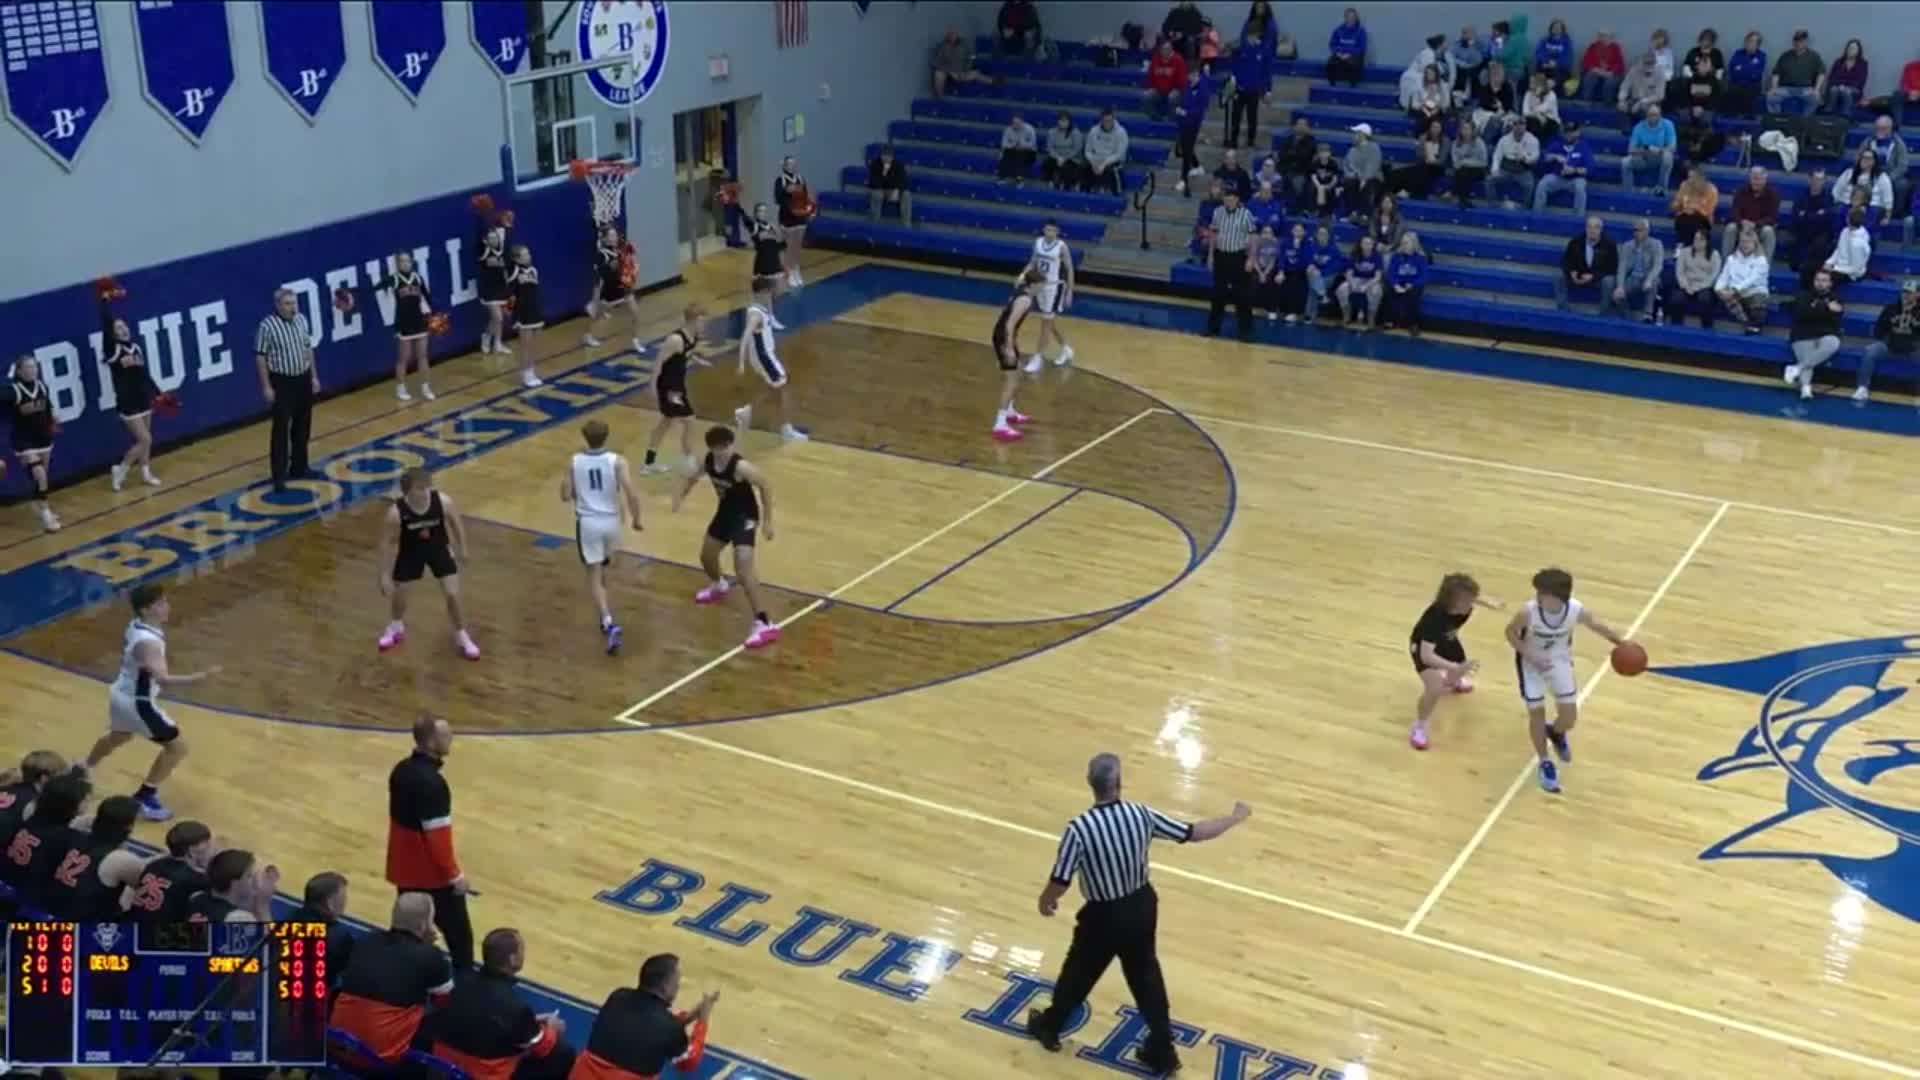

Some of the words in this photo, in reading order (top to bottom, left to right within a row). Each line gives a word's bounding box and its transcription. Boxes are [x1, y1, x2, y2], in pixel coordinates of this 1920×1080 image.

[617, 21, 634, 51] B
[588, 469, 605, 491] 11
[593, 857, 963, 1001] BLUE
[960, 969, 1352, 1080] DEV
